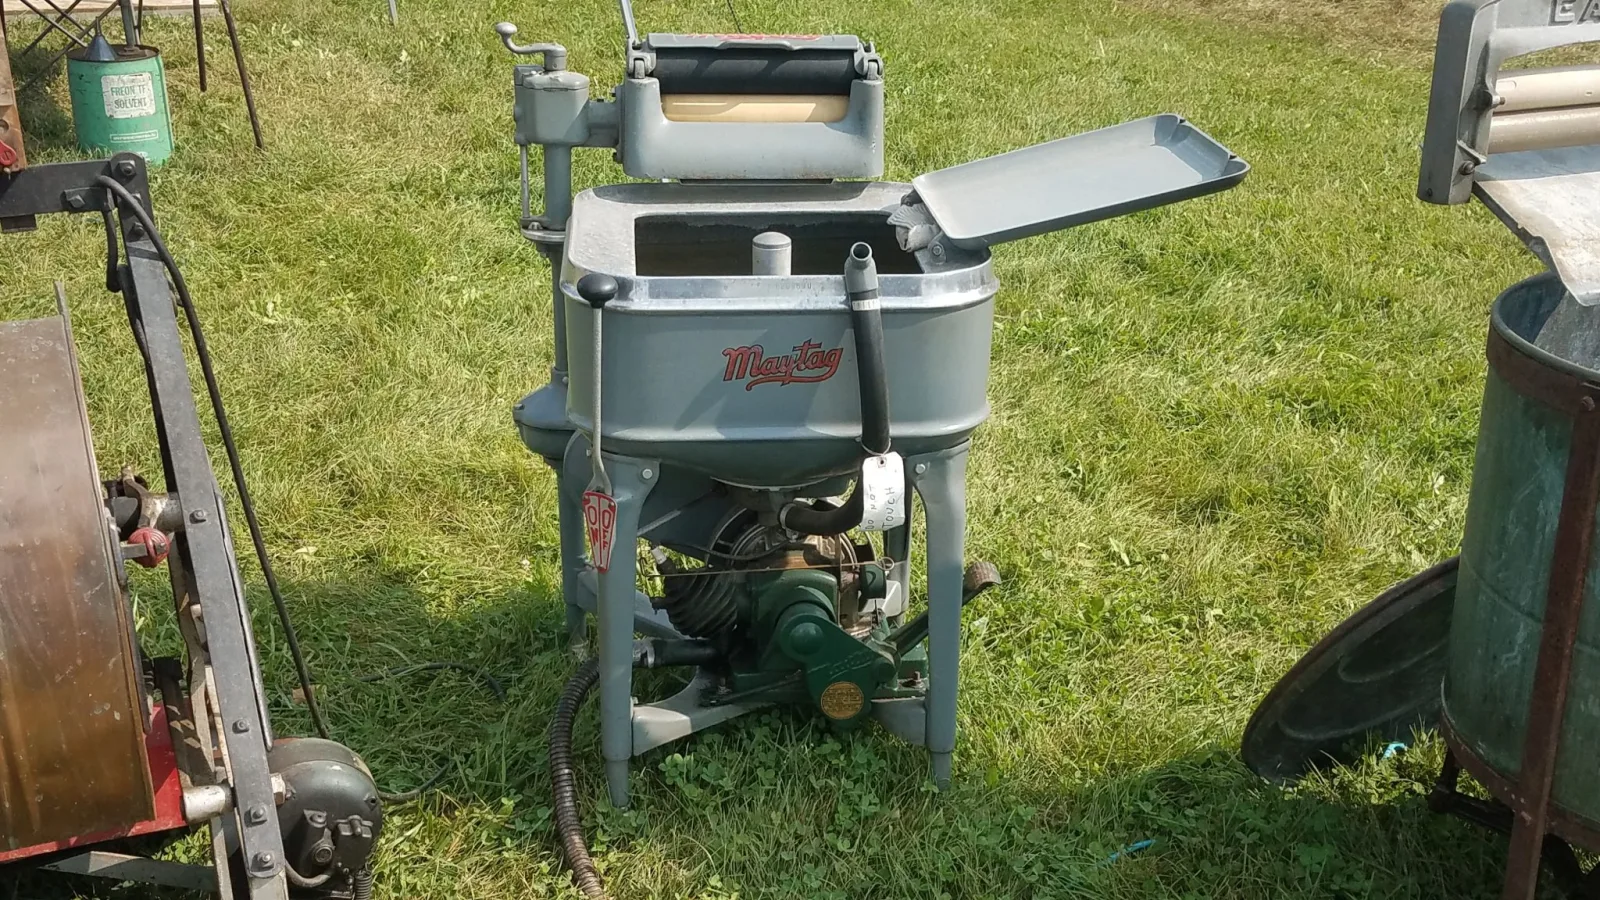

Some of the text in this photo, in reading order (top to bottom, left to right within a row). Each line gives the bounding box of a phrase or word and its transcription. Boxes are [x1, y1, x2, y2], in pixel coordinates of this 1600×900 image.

[110, 84, 146, 97] FREON TF
[114, 97, 147, 109] SOLVENT
[721, 338, 844, 391] Maytag
[587, 505, 598, 547] ON
[881, 487, 895, 528] TOUCH
[602, 509, 611, 550] OFF
